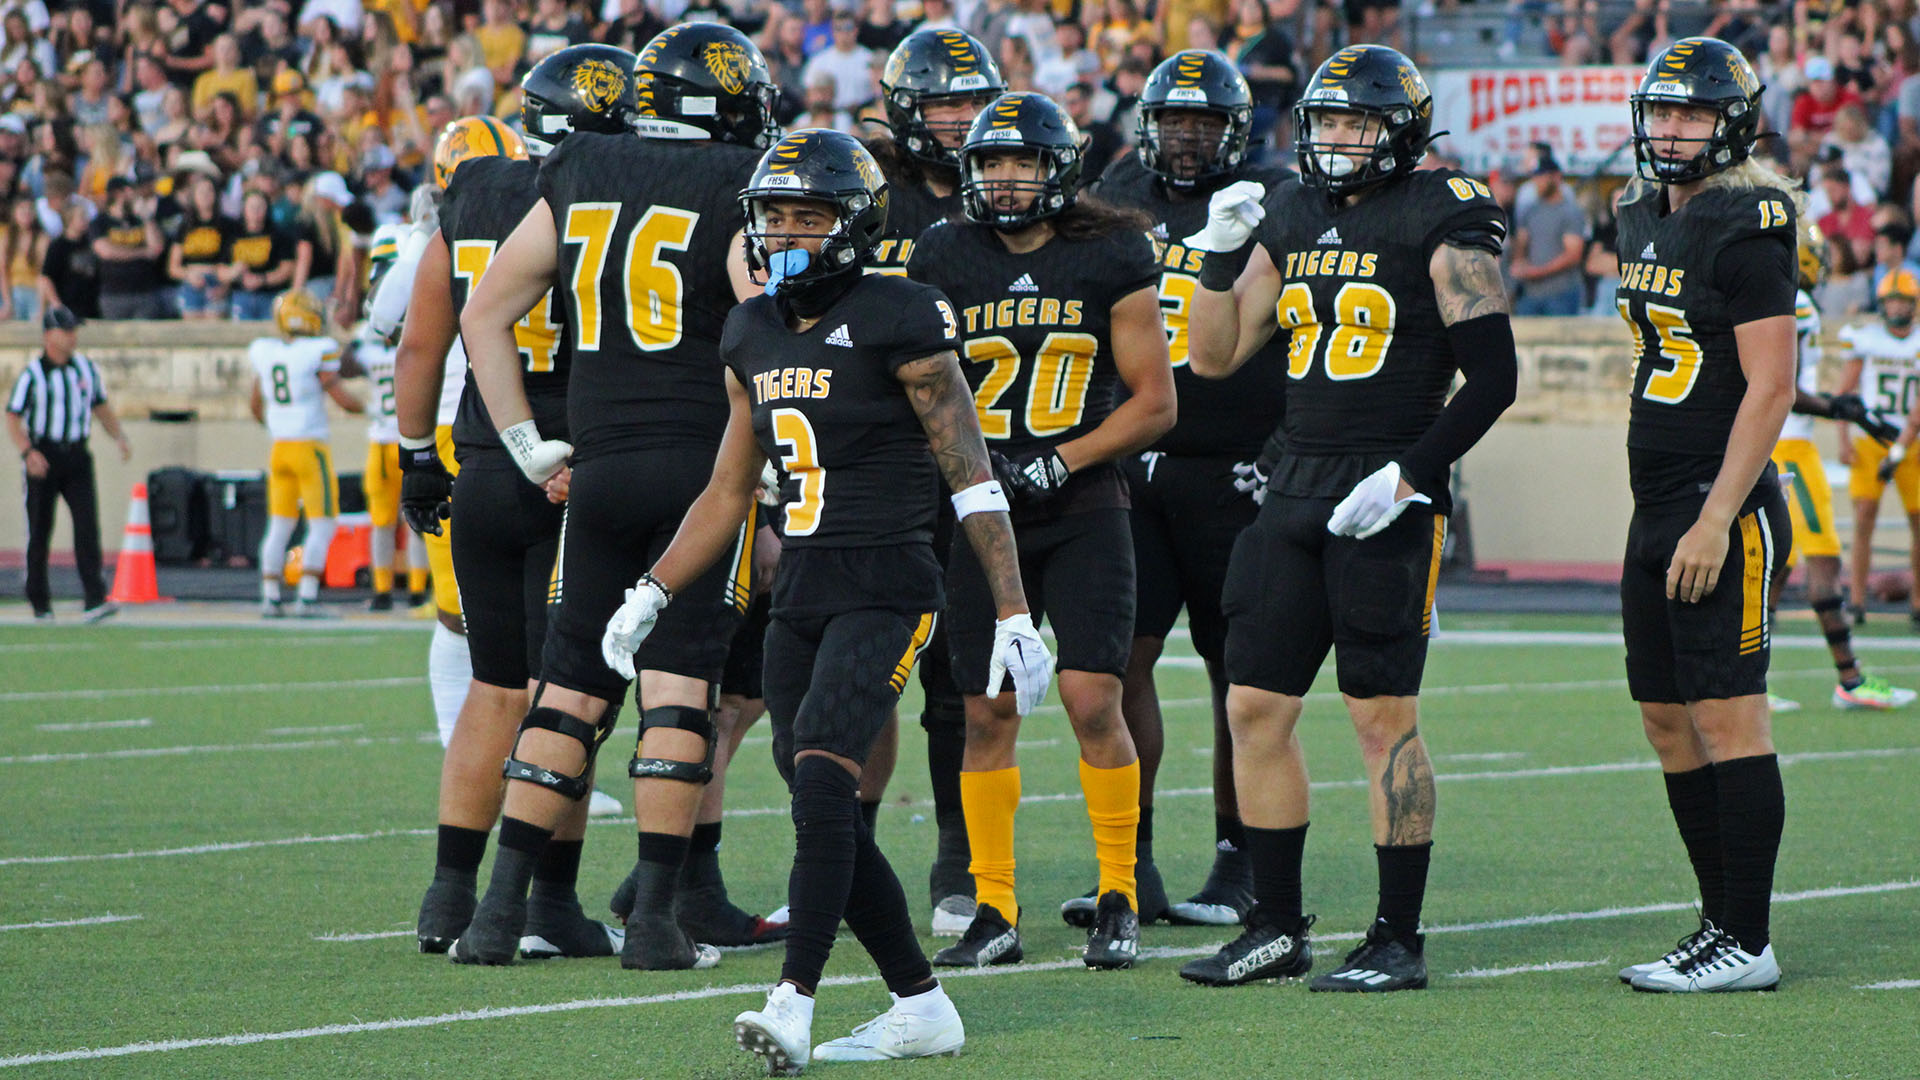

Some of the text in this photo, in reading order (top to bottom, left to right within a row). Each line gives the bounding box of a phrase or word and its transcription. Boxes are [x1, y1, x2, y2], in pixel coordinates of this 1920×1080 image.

[961, 77, 980, 86] FHSU
[662, 126, 680, 134] FORT
[767, 175, 790, 186] FHSU
[1758, 200, 1788, 229] 15
[563, 201, 700, 352] 76
[1285, 250, 1378, 279] TIGERS
[1618, 263, 1685, 297] TIGERS
[1008, 284, 1039, 292] adidas
[935, 300, 957, 339] 3
[963, 298, 1083, 333] TIGERS
[1276, 282, 1396, 382] 88
[825, 335, 853, 348] adidas
[1616, 298, 1704, 405] 15
[272, 364, 291, 404] 8
[753, 367, 833, 405] TIGERS
[964, 332, 1099, 439] 20
[1878, 373, 1920, 415] 50
[771, 407, 826, 536] 3
